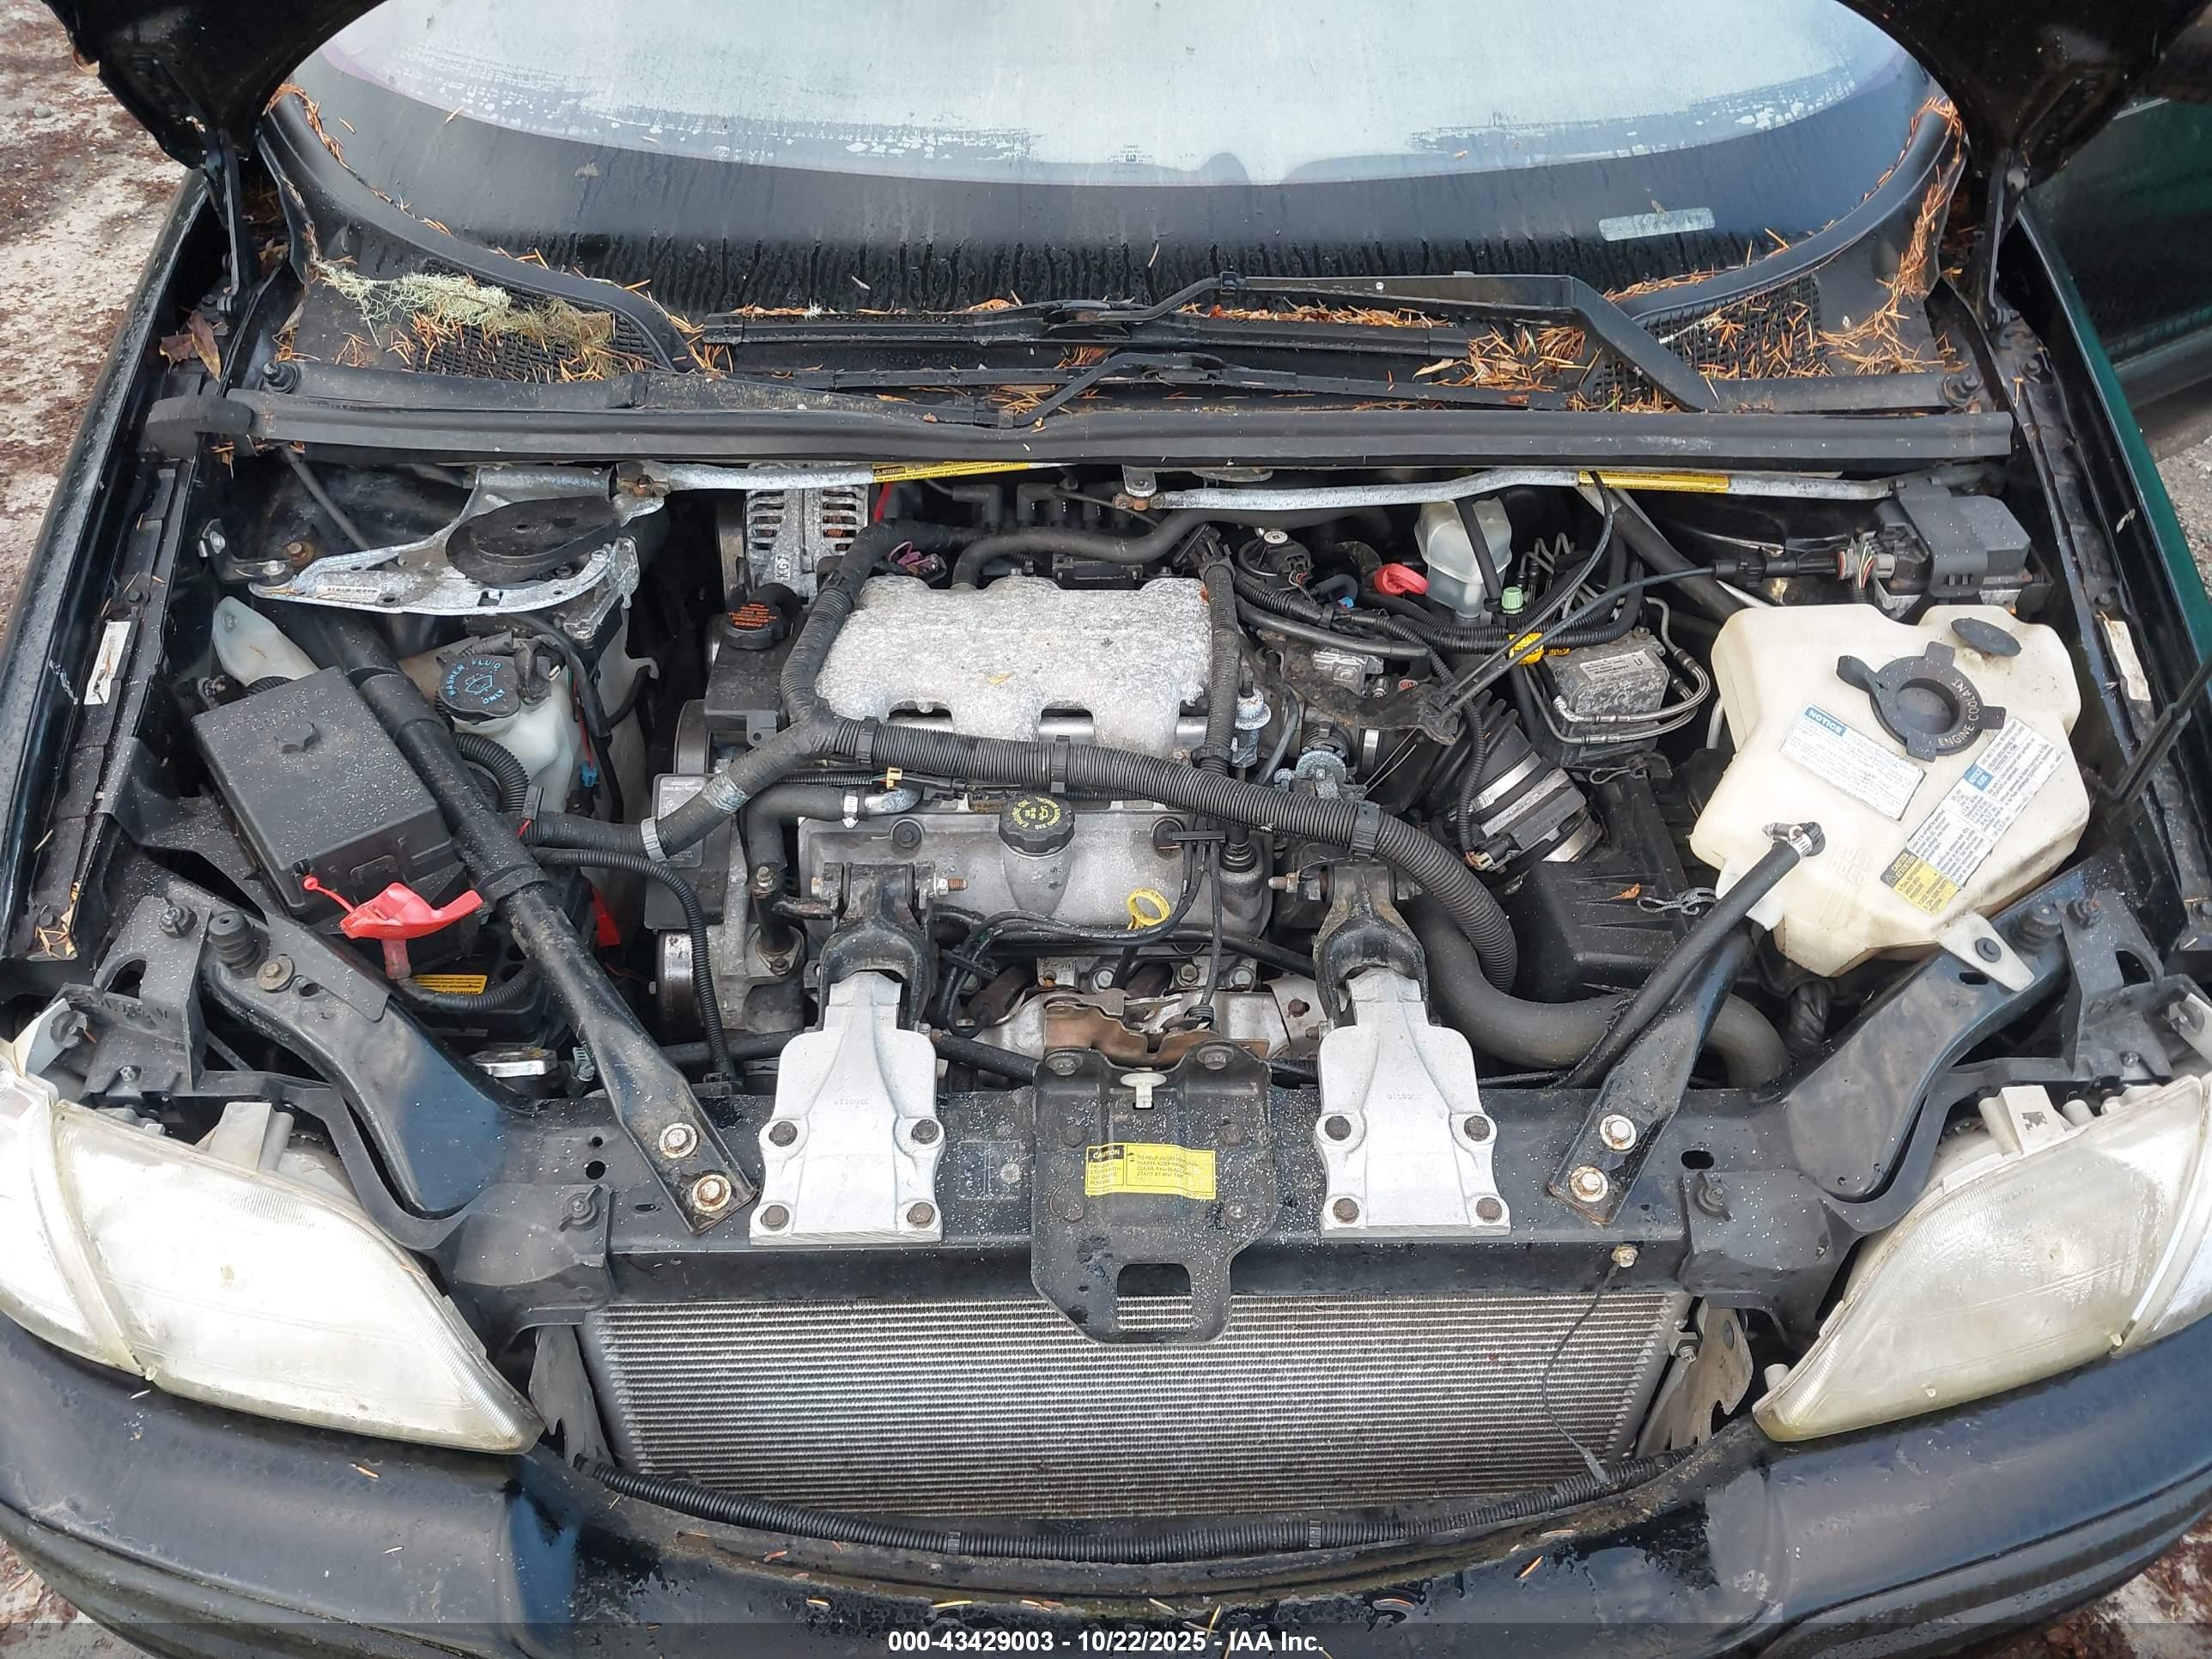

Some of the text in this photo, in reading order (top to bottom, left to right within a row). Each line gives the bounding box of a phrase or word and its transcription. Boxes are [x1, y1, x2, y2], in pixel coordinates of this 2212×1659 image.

[447, 659, 501, 696] WASHER FLUID
[482, 689, 505, 705] ONLY
[1808, 708, 1844, 734] NOTICE
[1937, 678, 1979, 746] ENGINE COOLANT
[1012, 799, 1031, 828] ENGINE OIL
[1092, 1150, 1120, 1159] CAUTION
